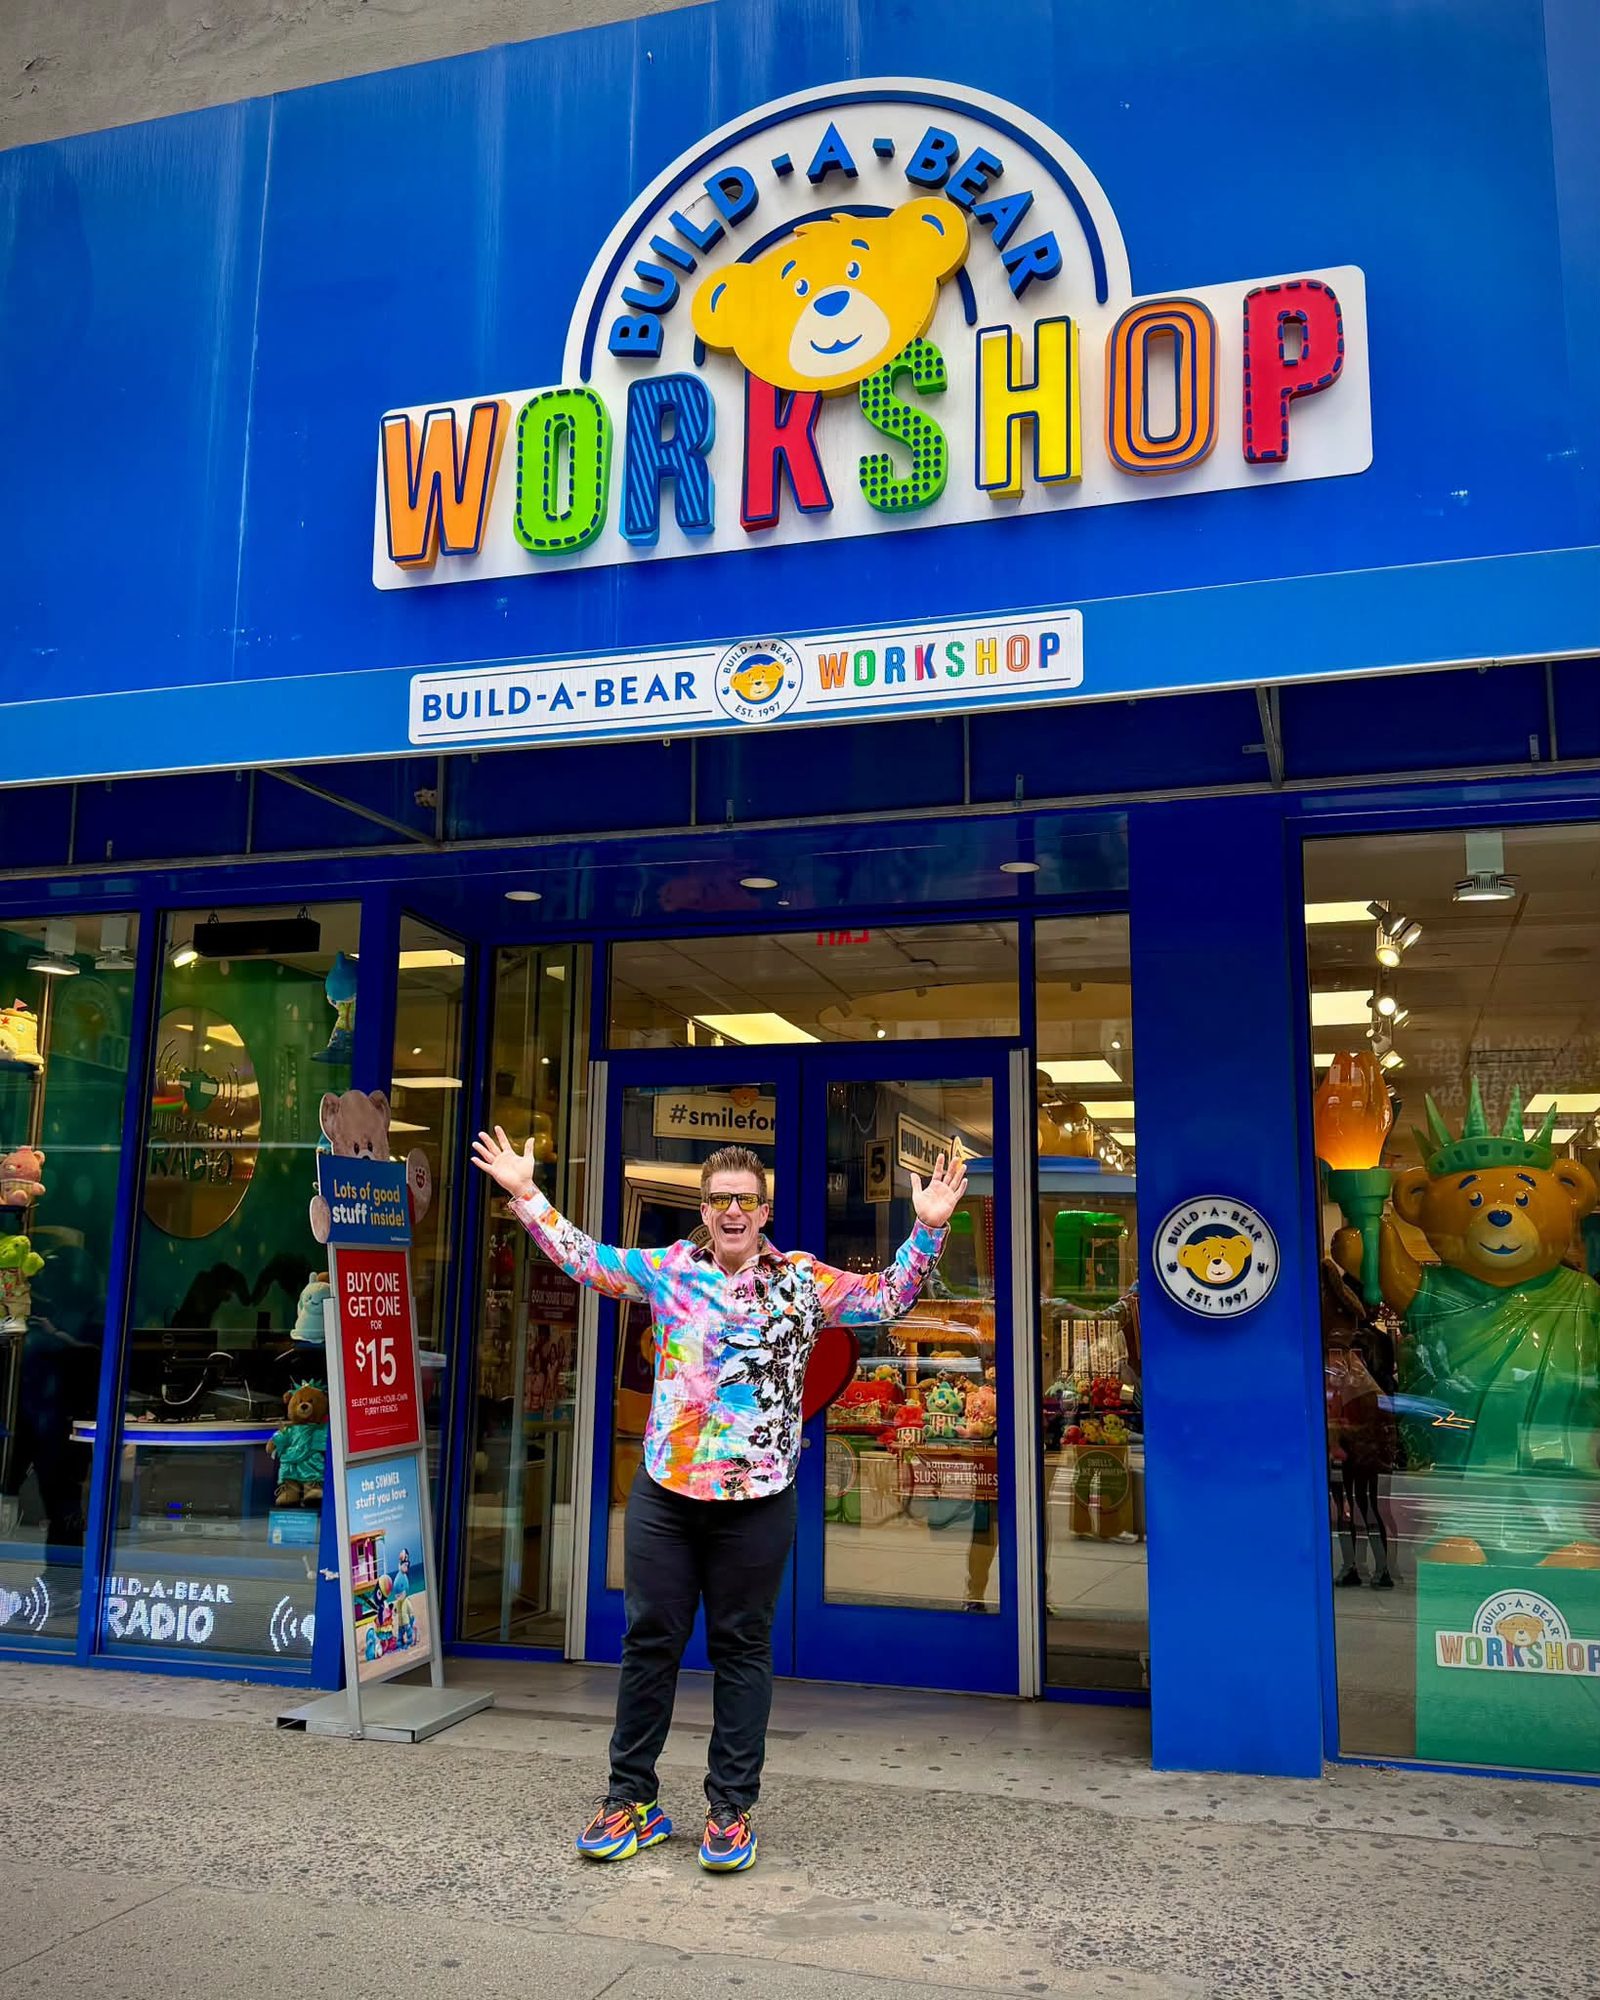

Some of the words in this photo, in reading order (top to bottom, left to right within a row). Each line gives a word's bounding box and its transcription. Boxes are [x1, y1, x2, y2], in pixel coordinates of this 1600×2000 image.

[607, 121, 1065, 359] BUILD-A-BEAR
[379, 279, 1344, 570] WORKSHOP
[723, 642, 793, 674] BUILD-A-BEAR
[819, 631, 1061, 690] WORKSHOP
[422, 671, 697, 723] BUILD-A-BEAR
[735, 704, 754, 718] EST.
[758, 701, 780, 717] 1997
[871, 1146, 886, 1183] 5
[333, 1179, 357, 1199] Lots
[359, 1182, 371, 1200] of
[373, 1184, 400, 1207] good
[332, 1202, 367, 1225] stuff
[370, 1206, 405, 1227] inside!
[1168, 1207, 1263, 1246] BUILD-A-BEAR
[347, 1272, 373, 1293] BUY
[374, 1272, 400, 1293] ONE
[1186, 1287, 1213, 1308] EST.
[1218, 1287, 1250, 1308] 1997
[347, 1296, 373, 1317] GET
[375, 1296, 401, 1316] ONE
[370, 1320, 383, 1331] FOR
[355, 1336, 397, 1387] $15
[361, 1479, 374, 1492] the
[375, 1471, 400, 1488] SUMMER
[914, 1471, 951, 1484] SLUSHIE
[355, 1493, 376, 1510] stuff
[377, 1493, 391, 1508] you
[391, 1488, 407, 1501] love
[105, 1597, 214, 1643] RADIO
[1481, 1598, 1560, 1636] BUILD-A-BEAR
